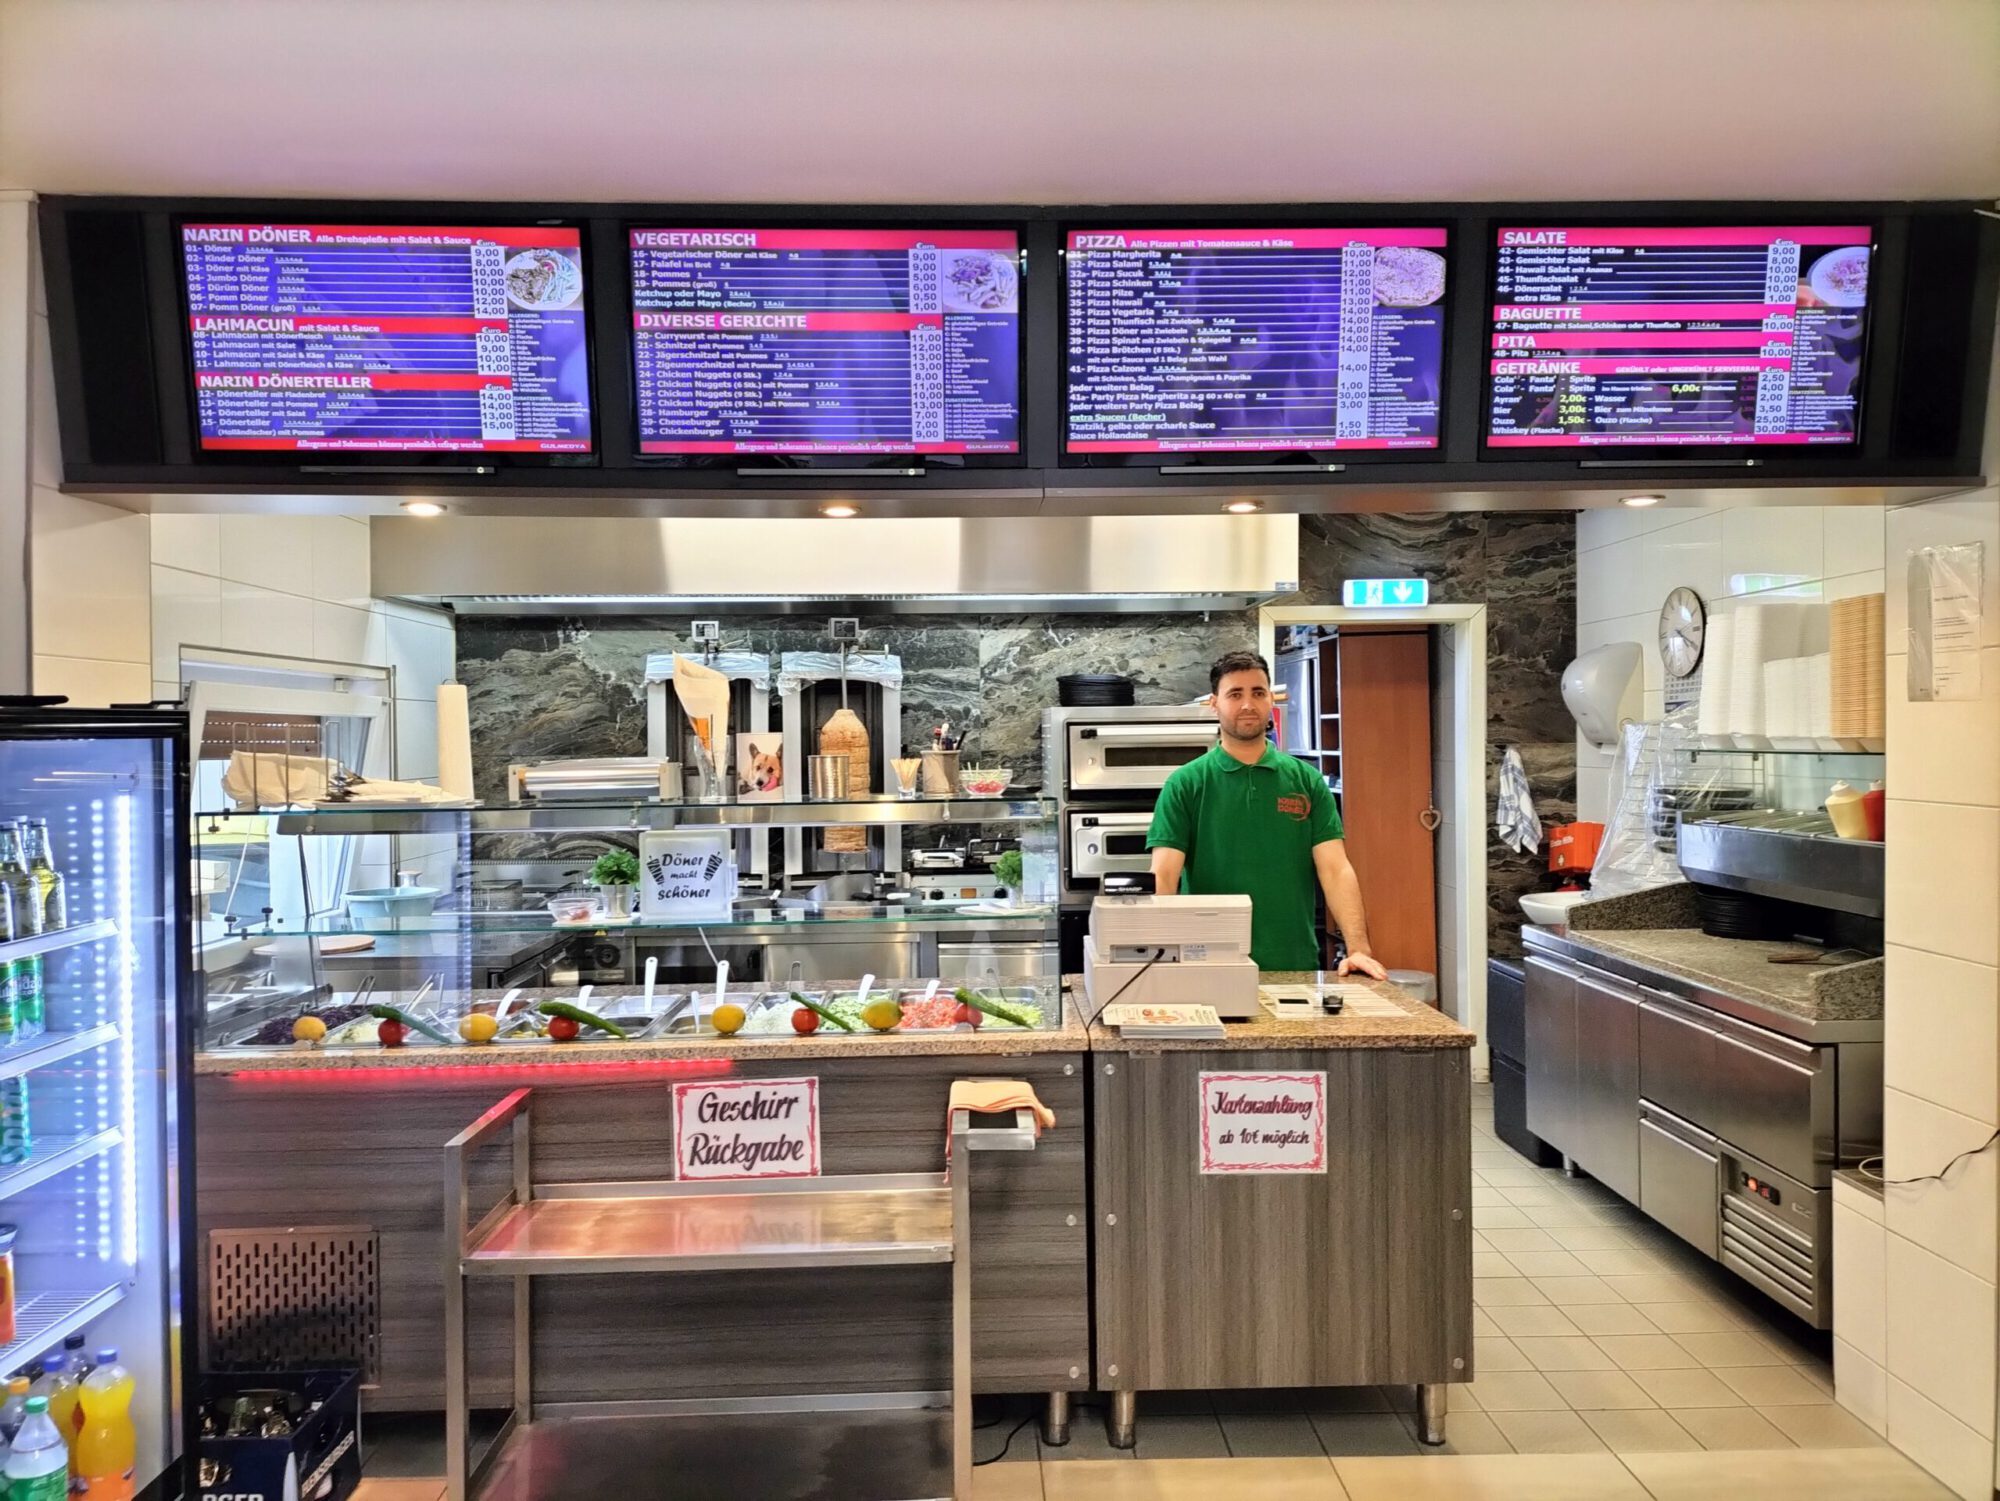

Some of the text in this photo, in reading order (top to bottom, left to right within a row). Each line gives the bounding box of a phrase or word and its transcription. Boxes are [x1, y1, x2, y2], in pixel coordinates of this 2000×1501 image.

[184, 229, 243, 242] NARIN
[249, 227, 311, 242] DÖNER
[1504, 232, 1566, 244] SALATE
[635, 233, 756, 245] VEGETARISCH
[1076, 236, 1126, 248] PIZZA
[475, 249, 499, 257] 9,00
[650, 251, 712, 259] Vegetarischer
[912, 253, 936, 261] 9,00
[1344, 250, 1371, 258] 10,00
[205, 254, 266, 262] Kinder Döner
[1772, 257, 1794, 265] 8,00
[476, 259, 499, 267] 8,00
[913, 263, 936, 271] 9,00
[1344, 260, 1371, 268] 11,00
[206, 264, 234, 272] Döner
[474, 269, 503, 277] 10,00
[913, 273, 936, 281] 5,00
[207, 274, 268, 282] Jumbo Döner
[1768, 276, 1797, 284] 10,00
[474, 279, 504, 287] 10,00
[913, 283, 936, 291] 6,00
[1343, 279, 1370, 287] 11,00
[242, 284, 269, 292] Döner
[474, 288, 504, 296] 10,00
[1343, 288, 1370, 296] 11,00
[240, 294, 268, 302] Döner
[913, 293, 936, 301] 0,50
[1770, 295, 1791, 303] 1,00
[475, 298, 504, 306] 12,00
[1343, 298, 1370, 306] 13,00
[241, 304, 268, 312] Döner
[476, 307, 505, 315] 14,00
[914, 303, 936, 311] 1,00
[1500, 308, 1581, 319] BAGUETTE
[196, 319, 294, 331] LAHMACUN
[640, 315, 806, 328] DIVERSE GERICHTE
[1765, 322, 1793, 330] 10,00
[478, 335, 508, 343] 10,00
[655, 332, 705, 340] Currywurst
[912, 334, 941, 342] 11,00
[1498, 336, 1535, 347] PITA
[481, 345, 505, 353] 9,00
[912, 344, 941, 352] 12,00
[479, 355, 509, 363] 10,00
[480, 364, 509, 372] 11,00
[913, 363, 942, 371] 13,00
[1340, 364, 1367, 372] 14,00
[1496, 360, 1580, 374] GETRÄNKE
[200, 374, 373, 388] NARIN DÖNERTELLER
[915, 373, 938, 381] 8,00
[1762, 375, 1784, 383] 2,50
[913, 383, 942, 391] 11,00
[1761, 384, 1783, 392] 4,00
[481, 393, 511, 401] 14,00
[913, 392, 942, 400] 10,00
[1339, 392, 1367, 400] 30,00
[1760, 394, 1782, 402] 2,00
[482, 402, 512, 410] 14,00
[914, 402, 942, 410] 13,00
[1340, 401, 1362, 409] 3,00
[483, 412, 512, 420] 13,00
[659, 409, 709, 417] Hamburger
[916, 412, 938, 420] 7,00
[659, 419, 720, 427] Cheeseburger
[1757, 416, 1785, 424] 25,00
[483, 422, 513, 430] 15,00
[916, 421, 938, 429] 7,00
[660, 428, 724, 436] Chickenburger
[916, 430, 938, 439] 9,00
[1339, 430, 1361, 438] 2,00
[1493, 427, 1528, 435] Whiskey
[662, 853, 703, 866] Döner
[670, 871, 698, 879] macht
[658, 885, 710, 900] schöner
[698, 1091, 799, 1123] Geschirr
[1212, 1091, 1313, 1120] Kartenzahlung
[1219, 1130, 1234, 1144] ab
[1262, 1130, 1310, 1148] möglich
[687, 1133, 804, 1171] Rückgabe
